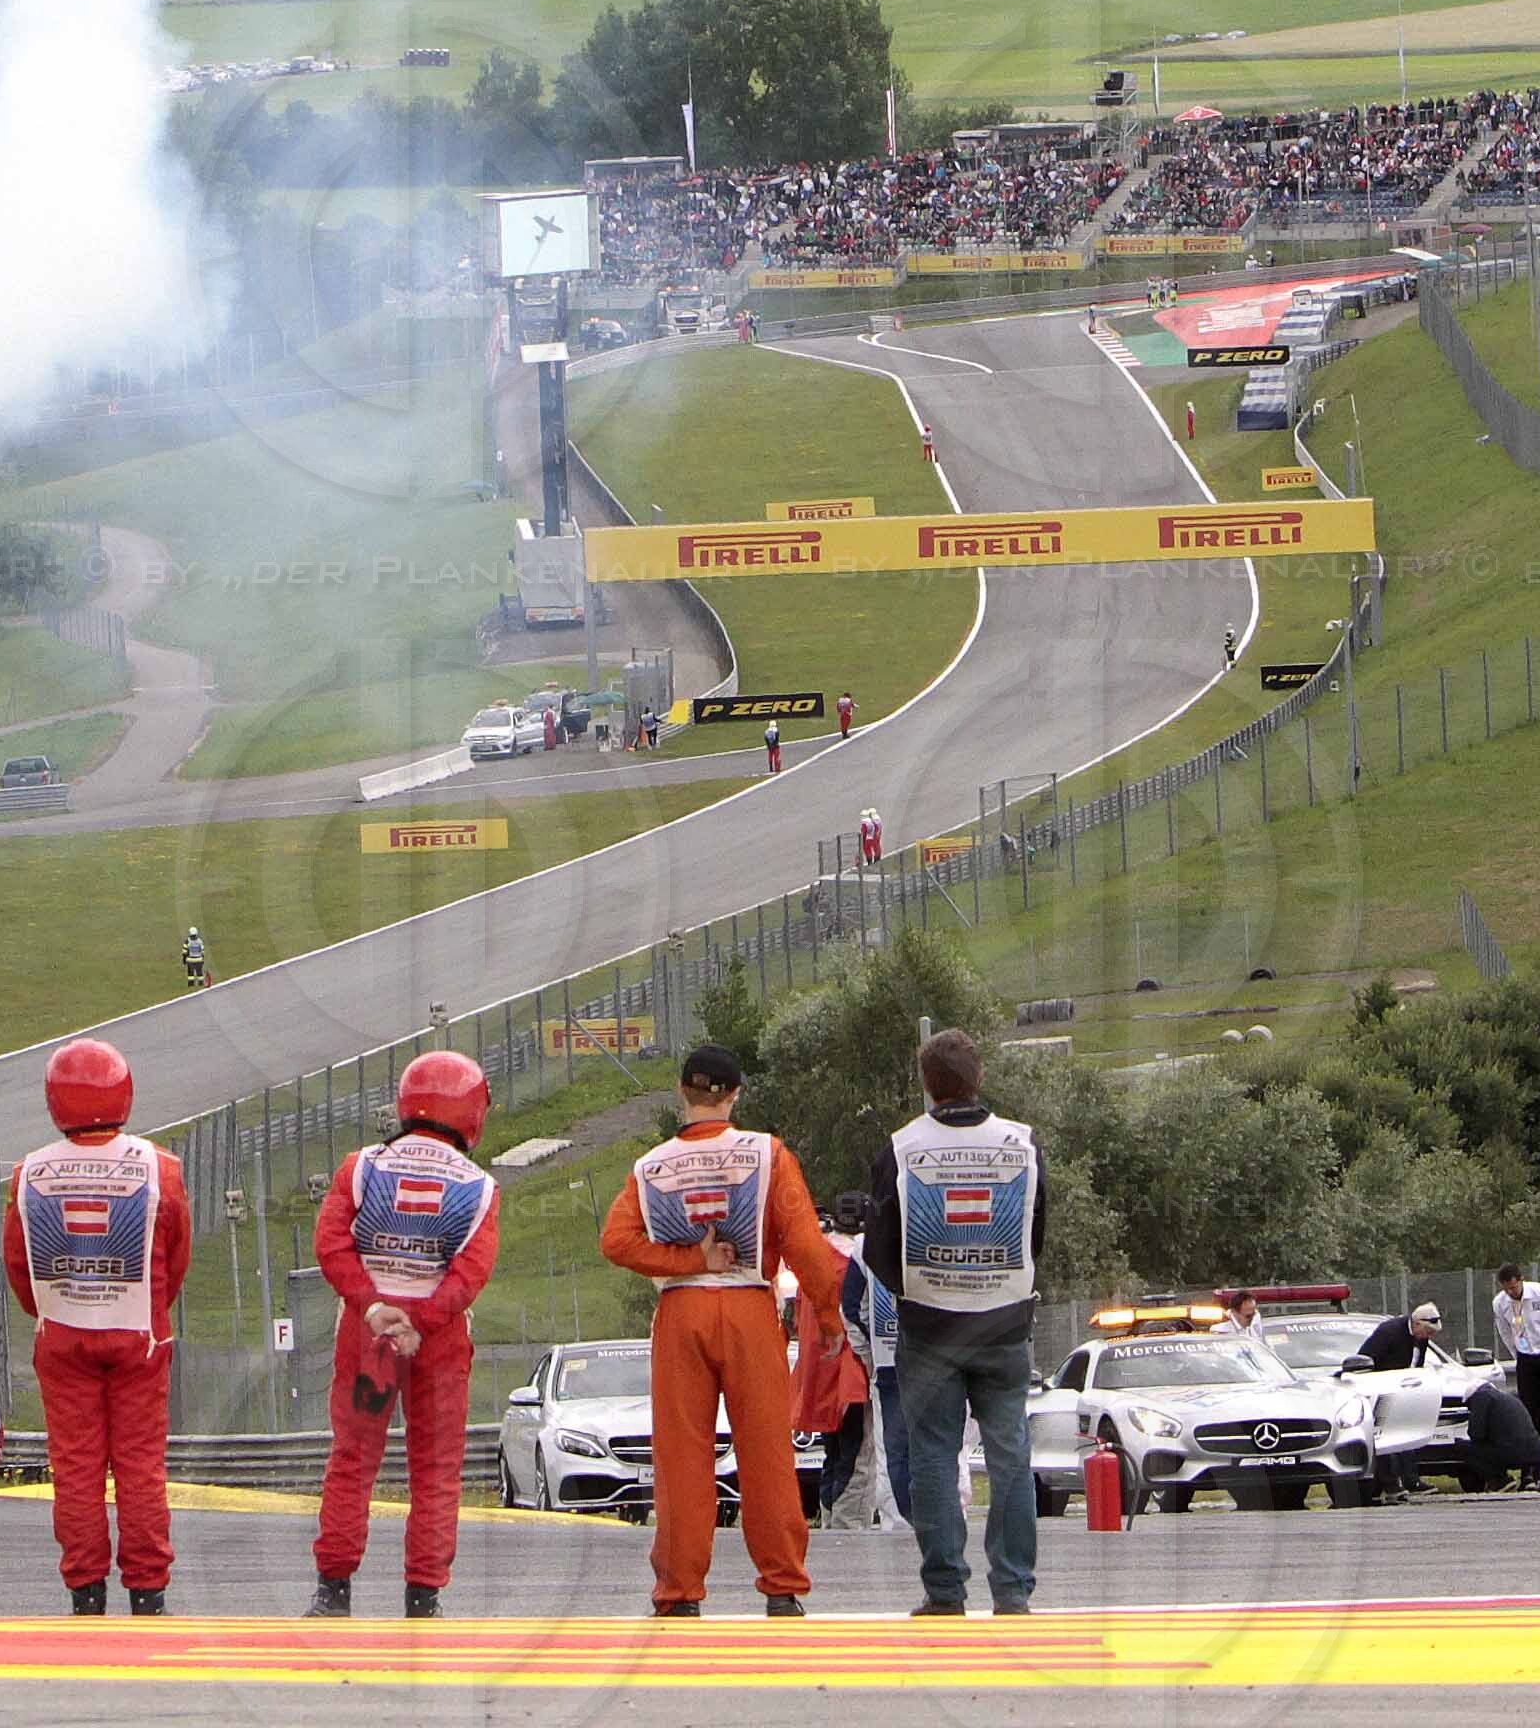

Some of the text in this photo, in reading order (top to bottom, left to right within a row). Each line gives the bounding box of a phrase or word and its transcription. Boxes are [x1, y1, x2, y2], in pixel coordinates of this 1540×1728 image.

[1108, 239, 1154, 253] PIRELLI
[1183, 238, 1227, 252] PIRELLI
[1022, 256, 1067, 268] PIRELLI
[1194, 349, 1284, 363] P ZERO
[1266, 471, 1312, 485] PIRELLI
[789, 502, 852, 520] PIRELLI
[1159, 512, 1303, 548] PIRELLI
[919, 522, 1062, 558] PIRELLI
[678, 531, 821, 567] PIRELLI
[701, 699, 817, 718] P ZERO
[390, 825, 477, 848] PIRELLI
[732, 1154, 756, 1164] 2015
[1001, 1153, 1023, 1164] 2015
[122, 1166, 145, 1176] 2015
[927, 1246, 1005, 1264] COURSE
[279, 1325, 288, 1345] F
